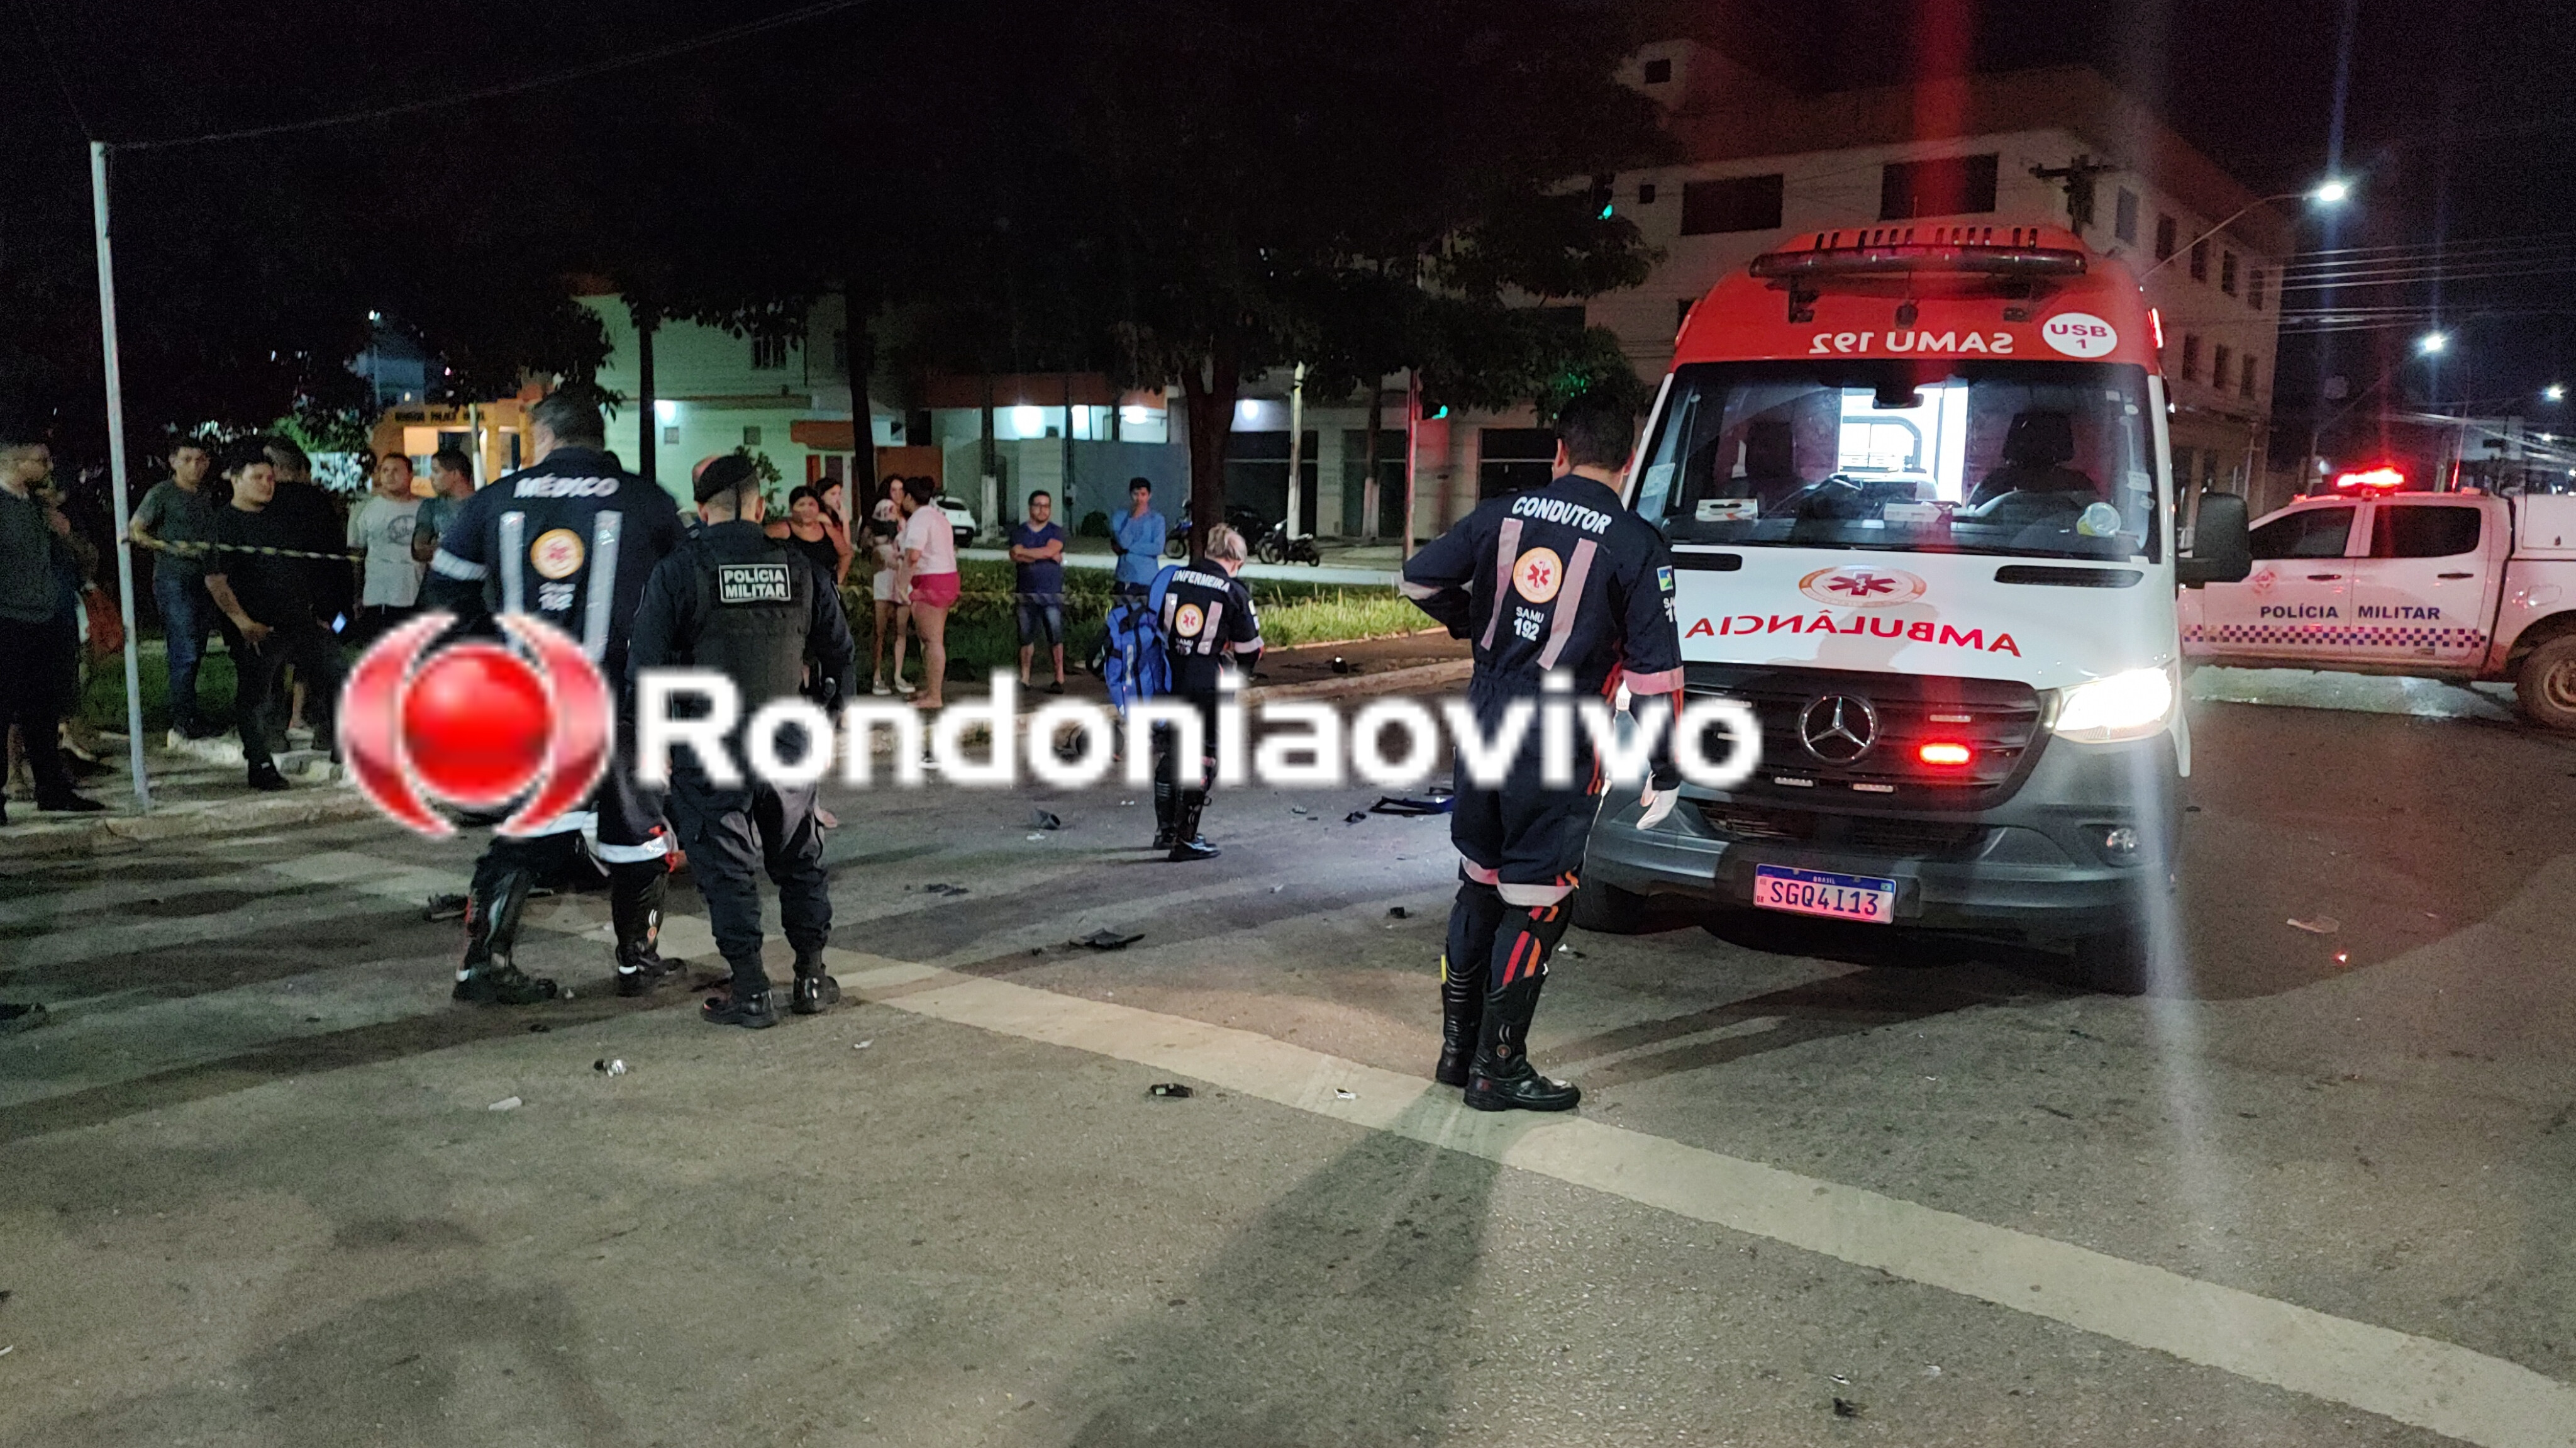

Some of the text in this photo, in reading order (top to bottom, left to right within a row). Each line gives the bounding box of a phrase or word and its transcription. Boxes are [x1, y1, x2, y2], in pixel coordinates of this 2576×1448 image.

[2050, 323, 2107, 338] USB
[2076, 339, 2087, 350] 1
[513, 473, 620, 498] MÉDICO
[1512, 496, 1612, 534] CONDUTOR
[725, 583, 786, 599] MILITAR
[1172, 570, 1230, 593] ENFERMEIRA
[1516, 606, 1544, 623] SAMU
[2260, 603, 2440, 620] POLÍCIA MILITAR
[1514, 618, 1540, 642] 192
[1770, 881, 1879, 915] SGQ4I13
